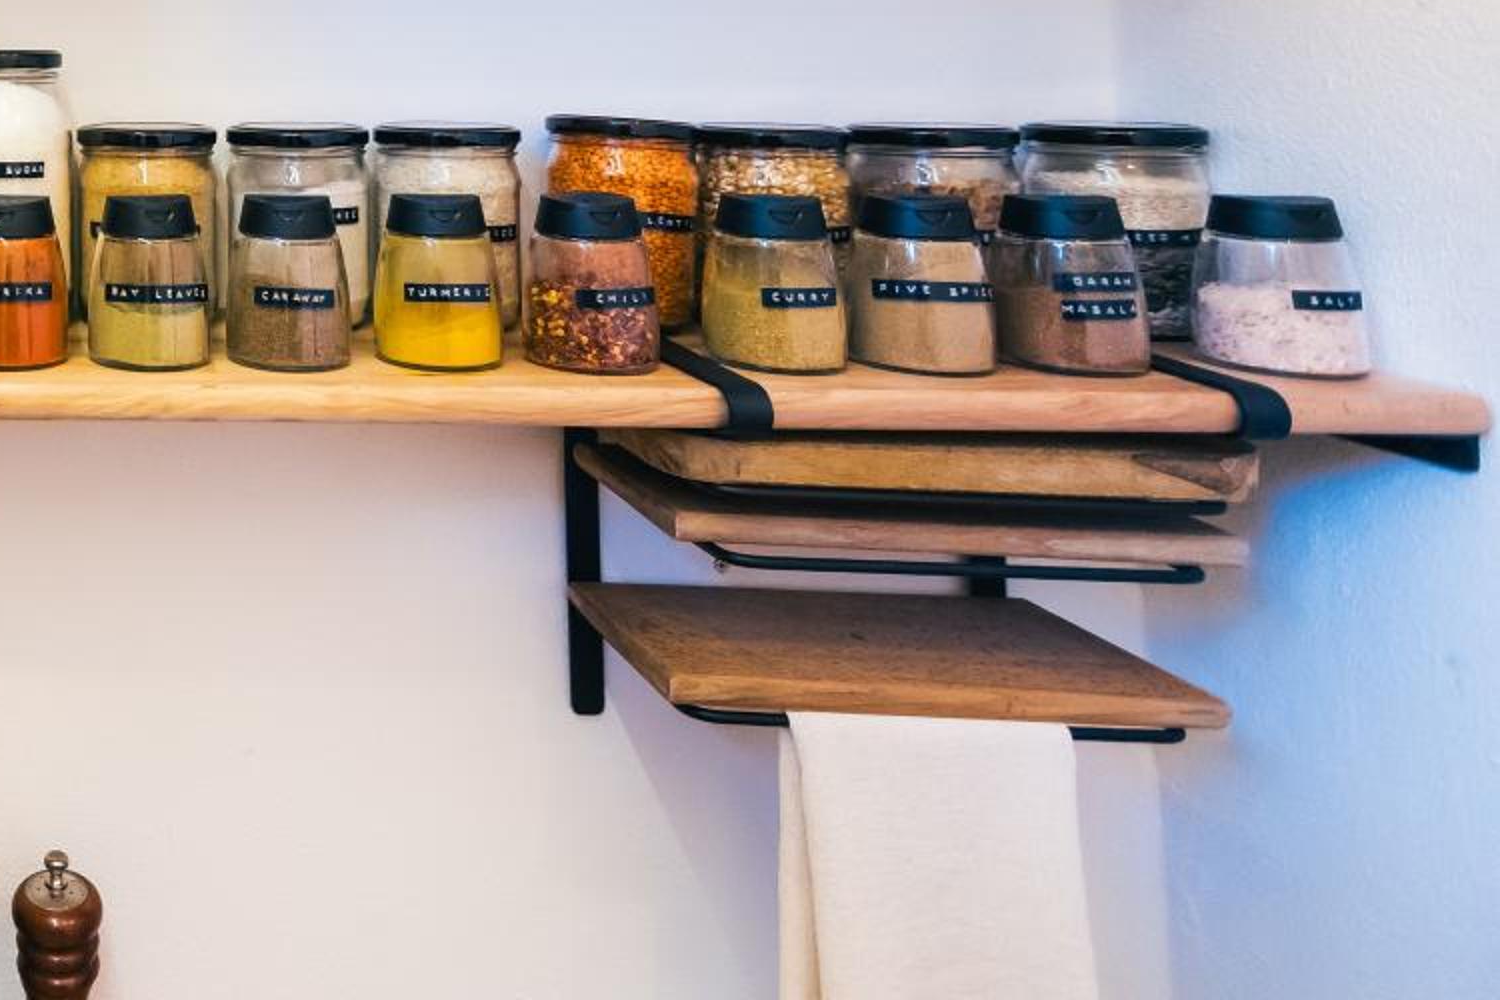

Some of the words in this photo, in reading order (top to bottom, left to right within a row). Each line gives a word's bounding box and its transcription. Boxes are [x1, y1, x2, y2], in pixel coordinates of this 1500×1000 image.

[111, 286, 140, 297] BAY
[879, 283, 931, 295] FIVE
[261, 290, 325, 303] CARAWAY
[771, 291, 829, 302] CURRY
[1310, 295, 1354, 308] SALT
[1061, 304, 1136, 315] MASALA
